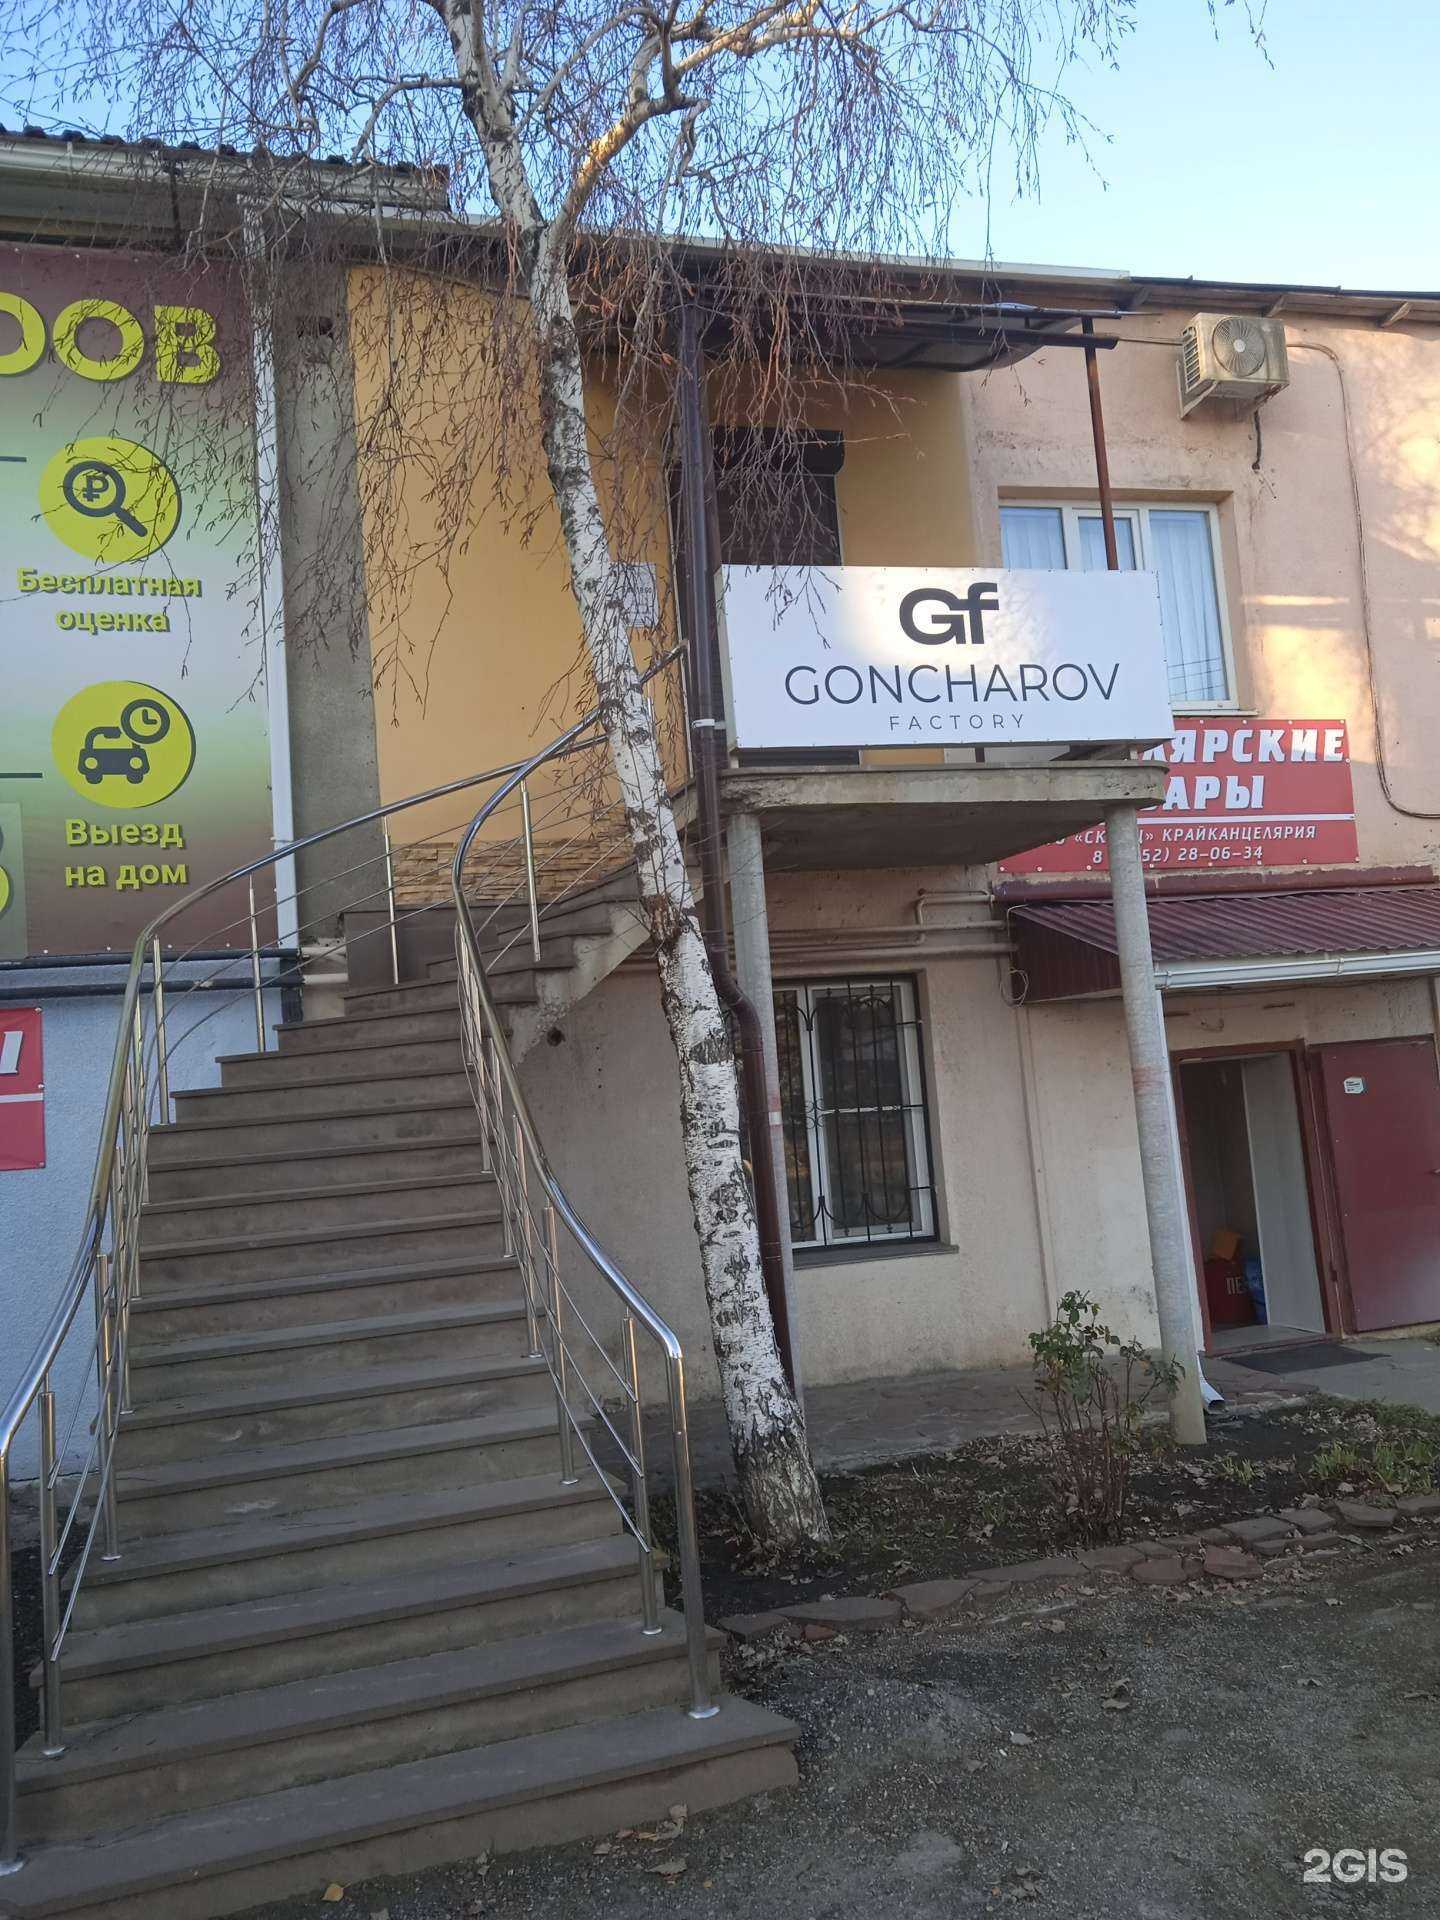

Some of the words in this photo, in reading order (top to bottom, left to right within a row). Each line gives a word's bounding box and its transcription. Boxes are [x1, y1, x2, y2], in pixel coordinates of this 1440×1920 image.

[16, 567, 202, 597] Бесплатная
[56, 608, 171, 635] оценка
[785, 663, 1120, 705] GONCHAROV
[889, 713, 1025, 731] FACTORY
[1139, 775, 1264, 811] АРЫ
[65, 818, 184, 849] Выезд
[1162, 825, 1316, 842] КРАЙКАНЦЕЛЯРИЯ
[1093, 850, 1103, 864] 8
[1178, 845, 1263, 861] 28-06-34
[65, 866, 105, 887] на
[116, 863, 187, 890] дом
